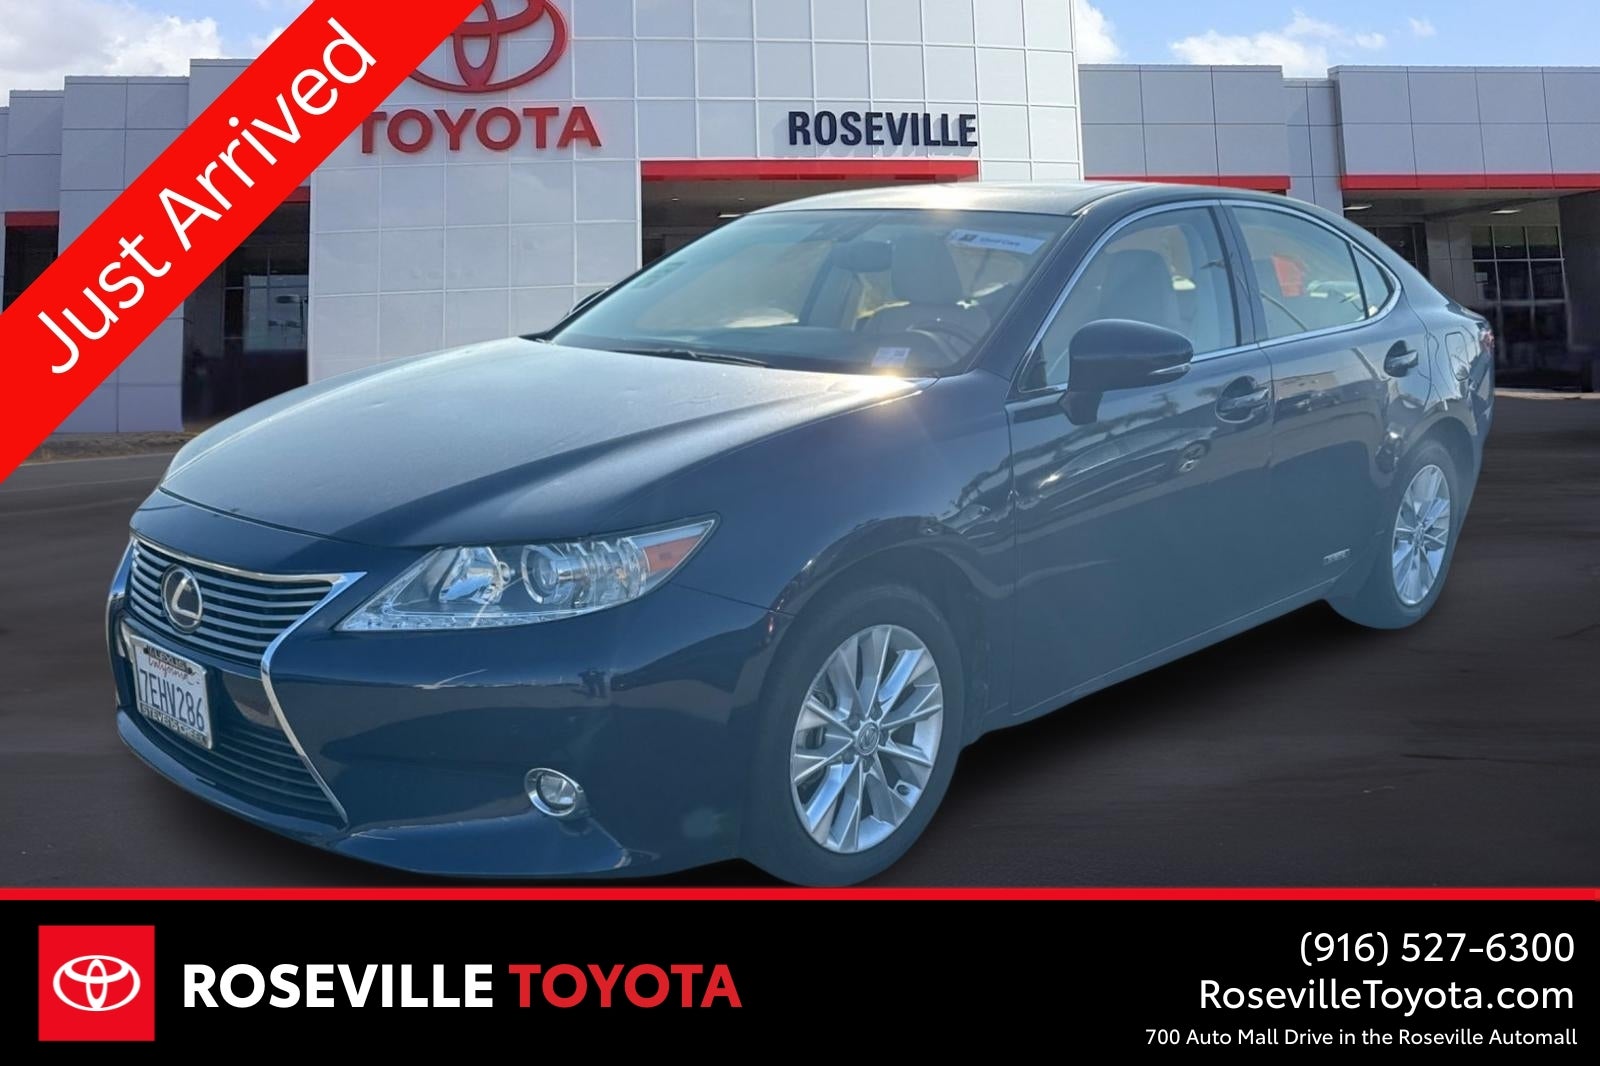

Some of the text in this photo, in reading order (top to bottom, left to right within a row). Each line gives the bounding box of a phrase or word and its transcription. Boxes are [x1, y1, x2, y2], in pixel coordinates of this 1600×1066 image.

[362, 106, 602, 154] TOYOTA
[788, 110, 978, 147] ROSEVILLE
[139, 669, 205, 732] 7EHV286
